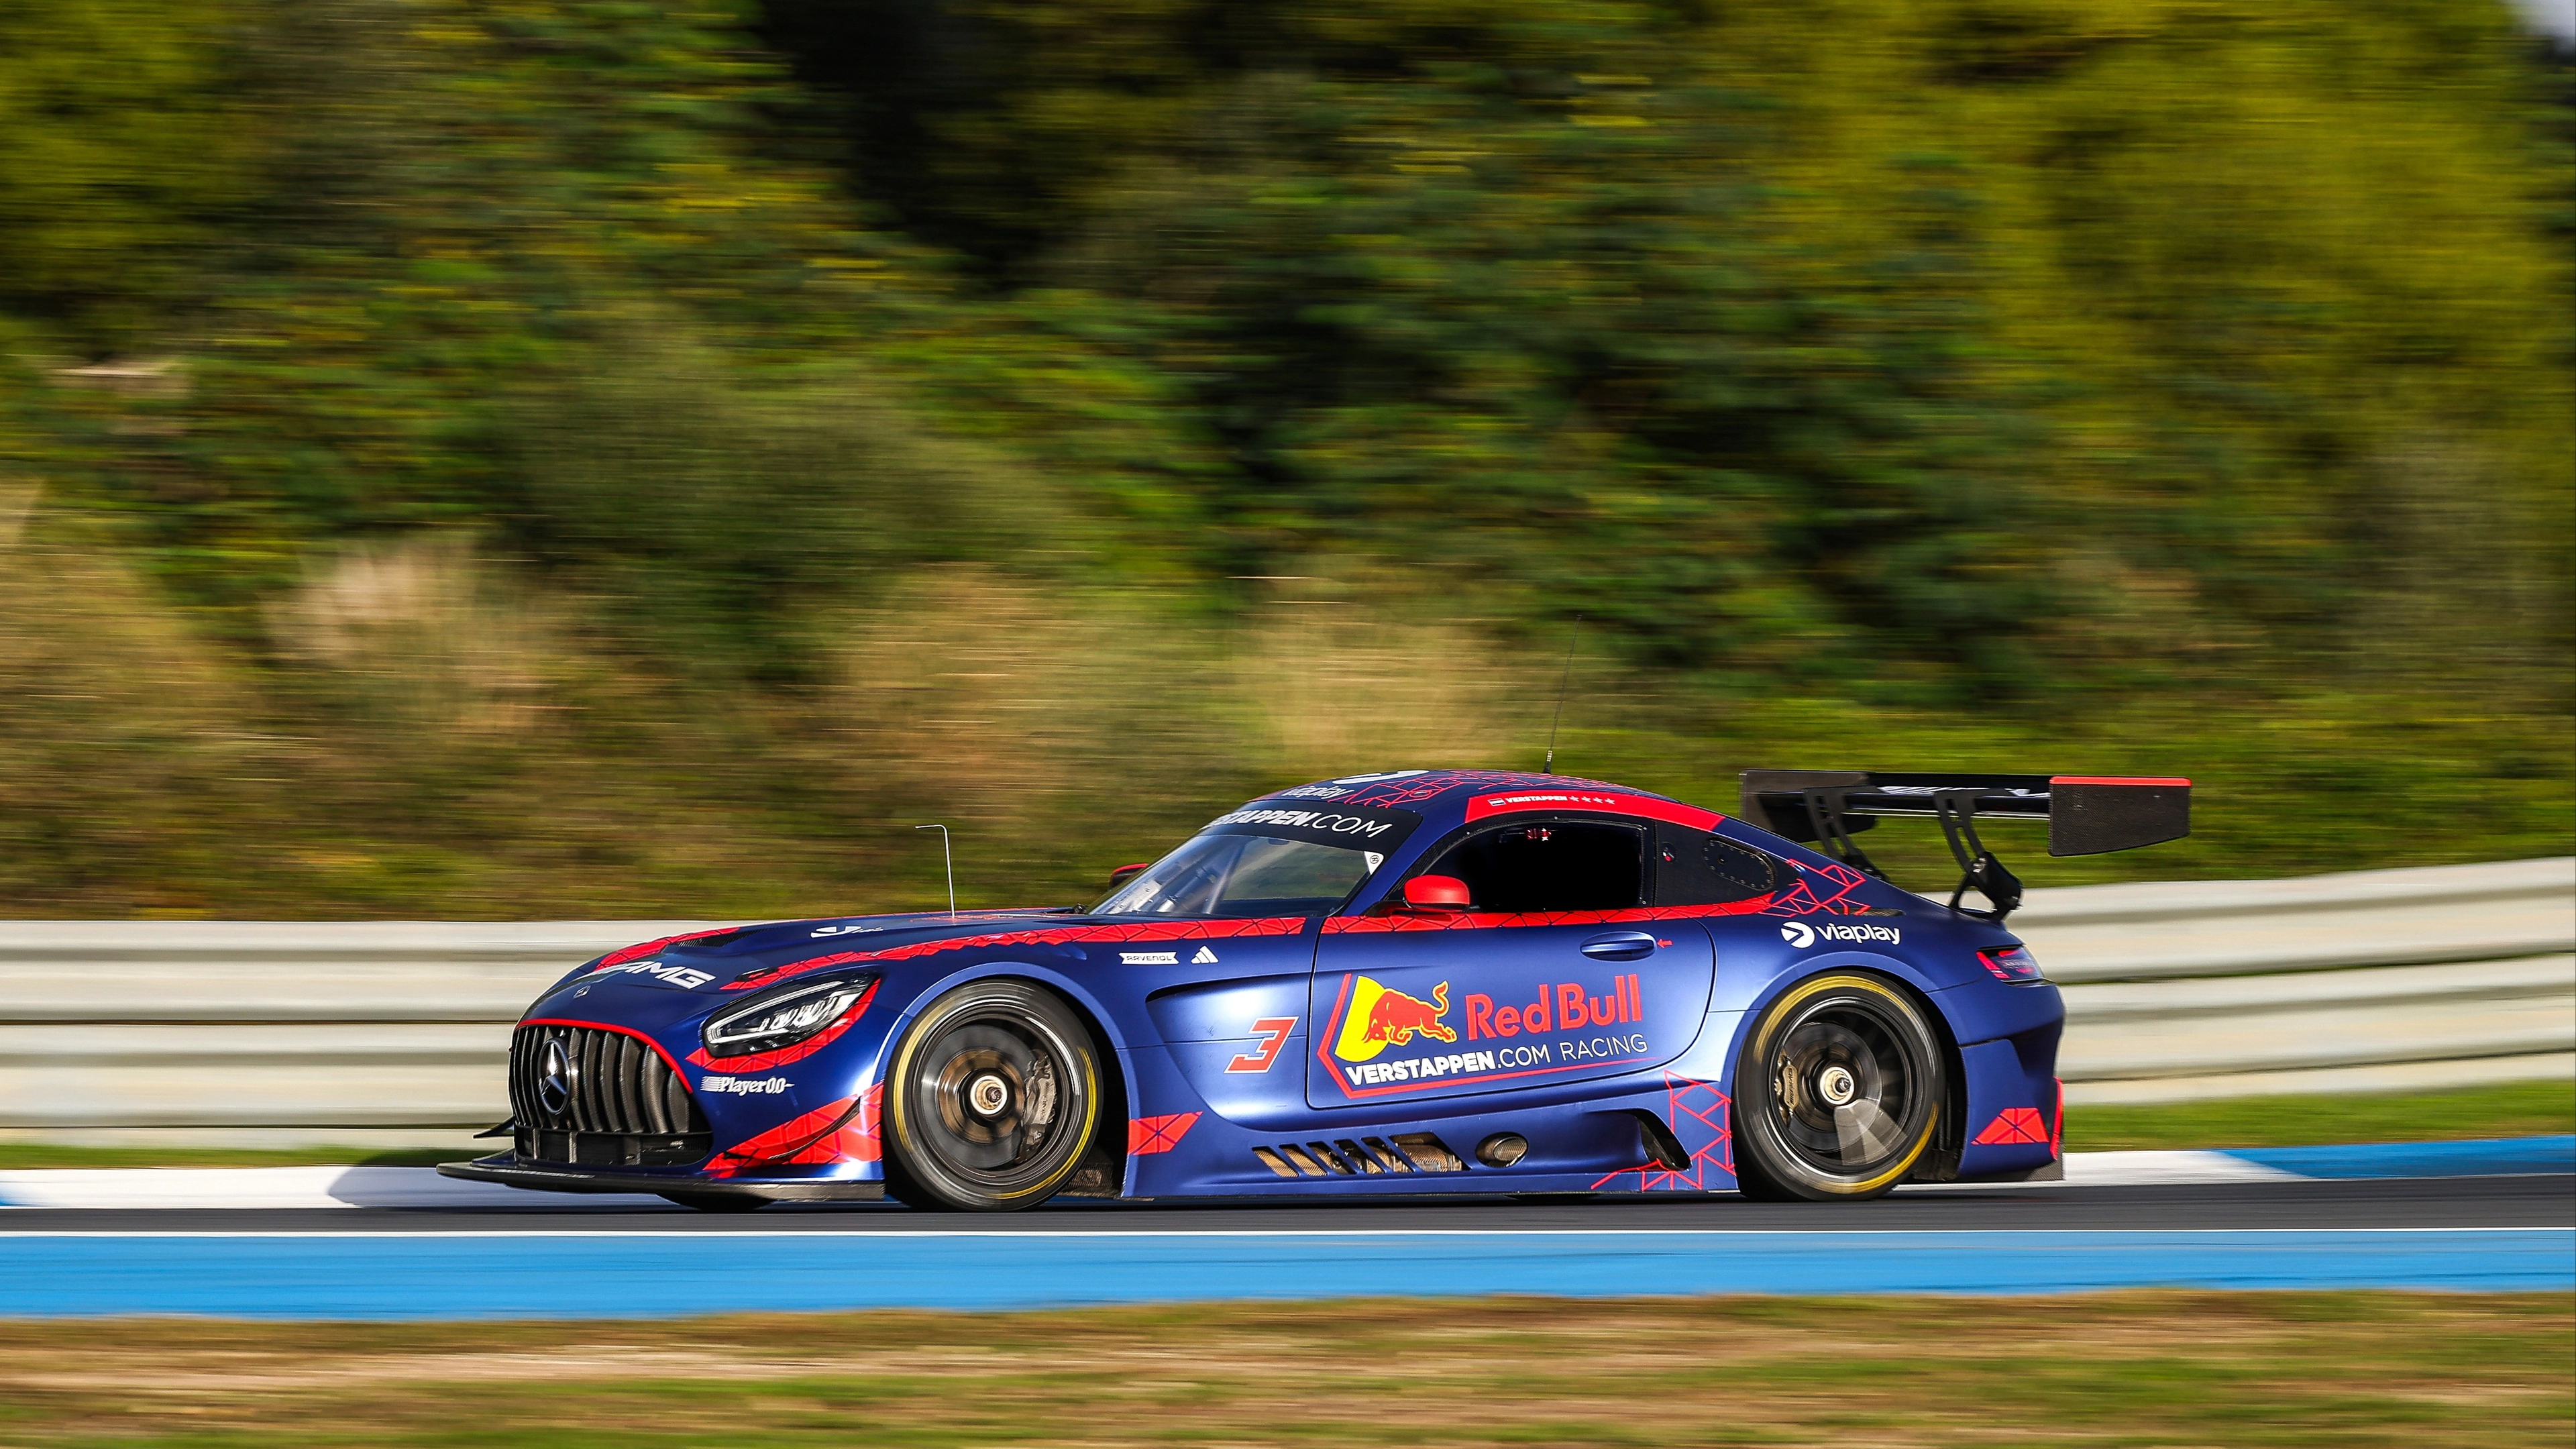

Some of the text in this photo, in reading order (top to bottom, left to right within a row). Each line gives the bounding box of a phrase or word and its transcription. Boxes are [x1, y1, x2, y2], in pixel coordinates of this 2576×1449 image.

[1505, 796, 1568, 804] VERSTAPPEN
[1815, 922, 1900, 945] viaplay
[1464, 973, 1642, 1040] Red Bull
[1223, 1016, 1299, 1074] 3
[1345, 1033, 1648, 1086] VERSTAPPEN.COM RACING
